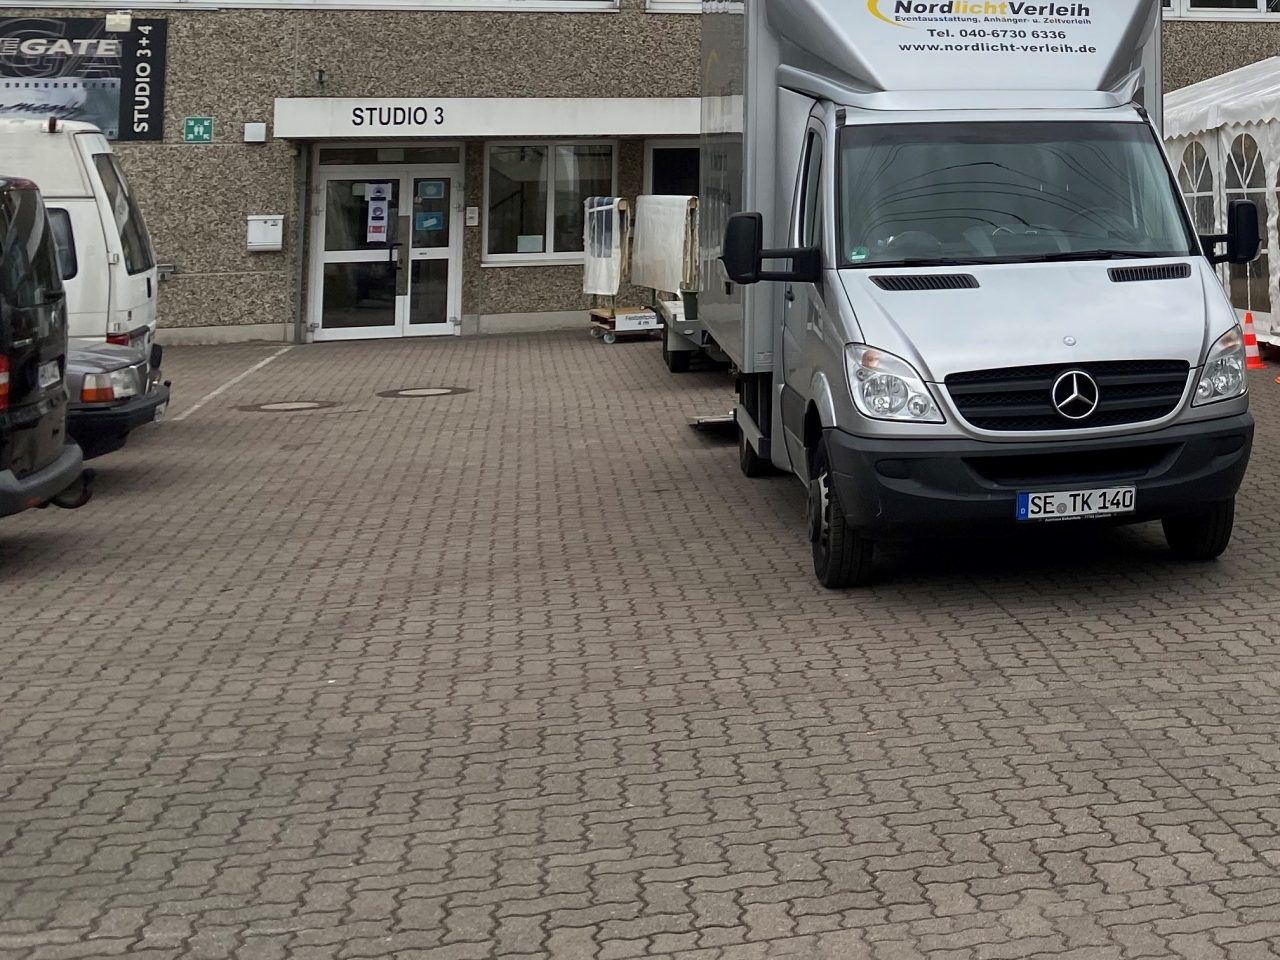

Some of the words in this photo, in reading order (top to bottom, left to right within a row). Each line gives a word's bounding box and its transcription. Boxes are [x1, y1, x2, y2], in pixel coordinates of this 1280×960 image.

[894, 0, 1090, 17] NordlichtVerleih
[895, 15, 981, 24] Eventausstattung,
[983, 17, 1030, 25] Anhänger-
[1043, 17, 1092, 25] Zeltverleih
[926, 28, 954, 38] Tel.
[959, 29, 1027, 39] 040-6730
[1031, 30, 1066, 39] 6336
[898, 43, 1097, 53] www.nordlicht-verleih.de
[134, 62, 151, 133] STUDIO
[352, 107, 428, 126] STUDIO
[434, 107, 444, 125] 3
[1030, 495, 1055, 514] SE
[1069, 492, 1093, 512] TK
[1098, 489, 1133, 510] 140
